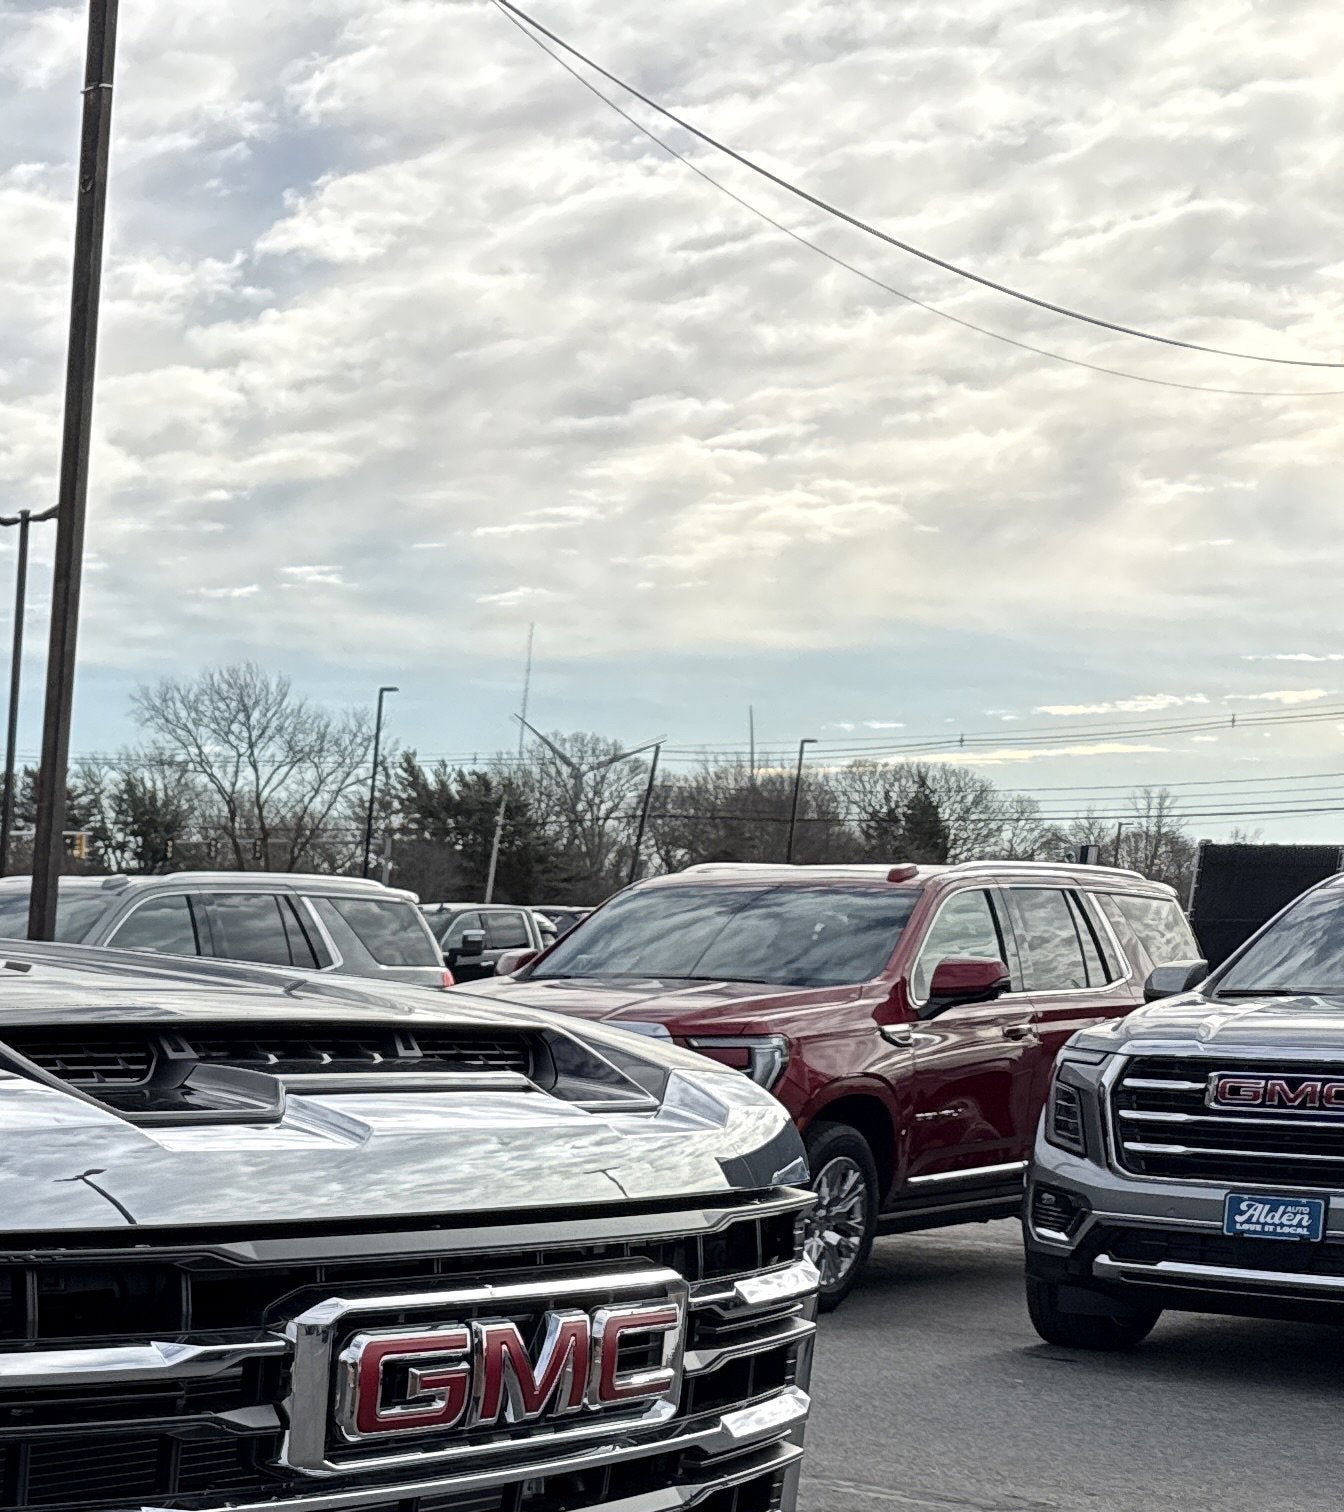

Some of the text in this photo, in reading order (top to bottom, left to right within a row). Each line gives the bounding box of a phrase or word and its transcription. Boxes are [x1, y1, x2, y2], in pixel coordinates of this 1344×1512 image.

[1234, 1201, 1312, 1226] Alden
[1276, 1226, 1310, 1234] LOCAL
[337, 1303, 680, 1442] GMC
